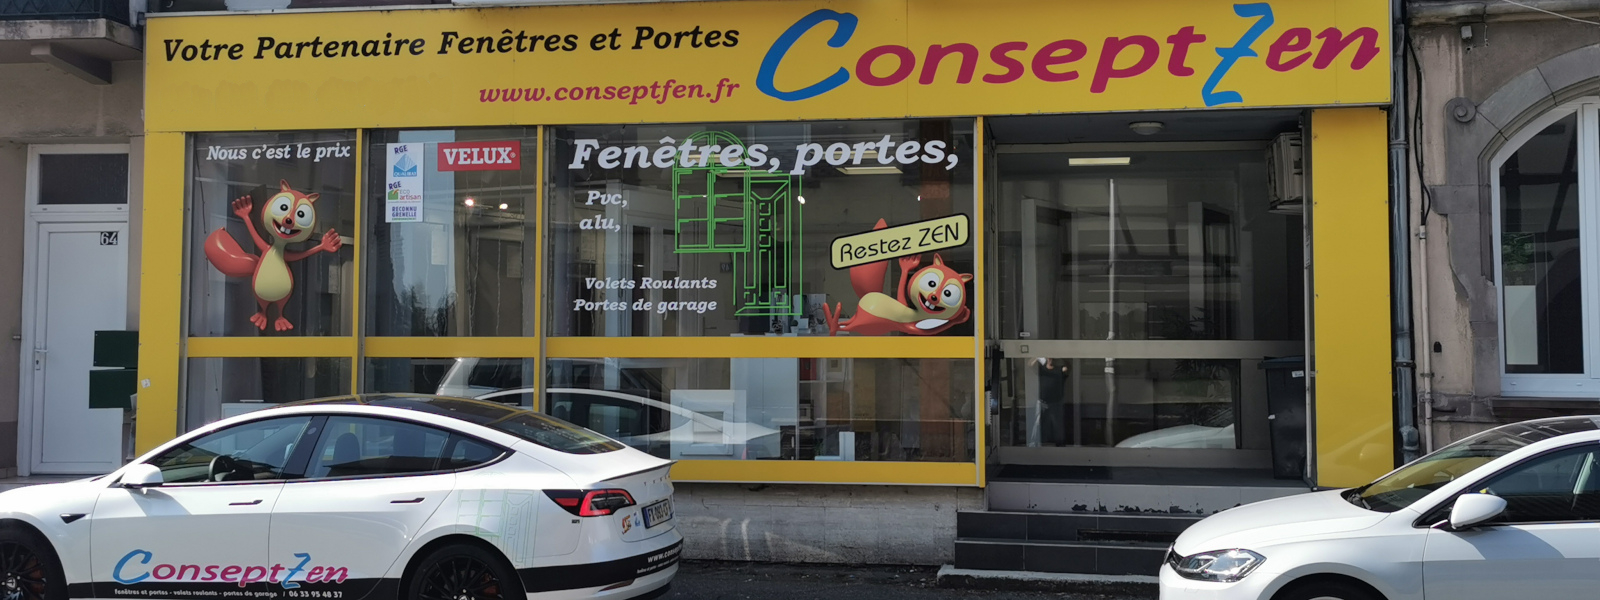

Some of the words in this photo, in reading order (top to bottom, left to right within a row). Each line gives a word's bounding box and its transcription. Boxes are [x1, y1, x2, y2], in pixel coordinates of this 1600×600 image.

[163, 38, 244, 62] Votre
[253, 32, 426, 60] Partenaire
[437, 28, 579, 55] Fenêtres
[589, 27, 622, 51] et
[631, 25, 740, 50] Portes
[756, 3, 1382, 108] ConseptZen
[479, 77, 742, 107] www.conseptfen.fr
[206, 145, 248, 161] Nous
[251, 144, 292, 160] c'est
[297, 142, 311, 159] le
[314, 142, 351, 163] prix
[394, 145, 408, 154] RGE
[568, 135, 783, 175] Fenêtres,
[791, 134, 960, 176] portes,
[388, 181, 401, 190] RGE
[585, 190, 628, 208] Pvc,
[579, 214, 621, 233] alu,
[101, 232, 118, 245] 64
[839, 236, 912, 263] Restez
[918, 222, 962, 248] ZEN
[585, 276, 636, 290] Volets
[639, 276, 718, 290] Roulants
[573, 298, 628, 311] Portes
[632, 298, 653, 311] de
[656, 301, 718, 315] garage
[112, 549, 349, 589] ConseptZen
[311, 590, 320, 598] 95
[322, 590, 332, 598] 48
[333, 590, 343, 598] 37
